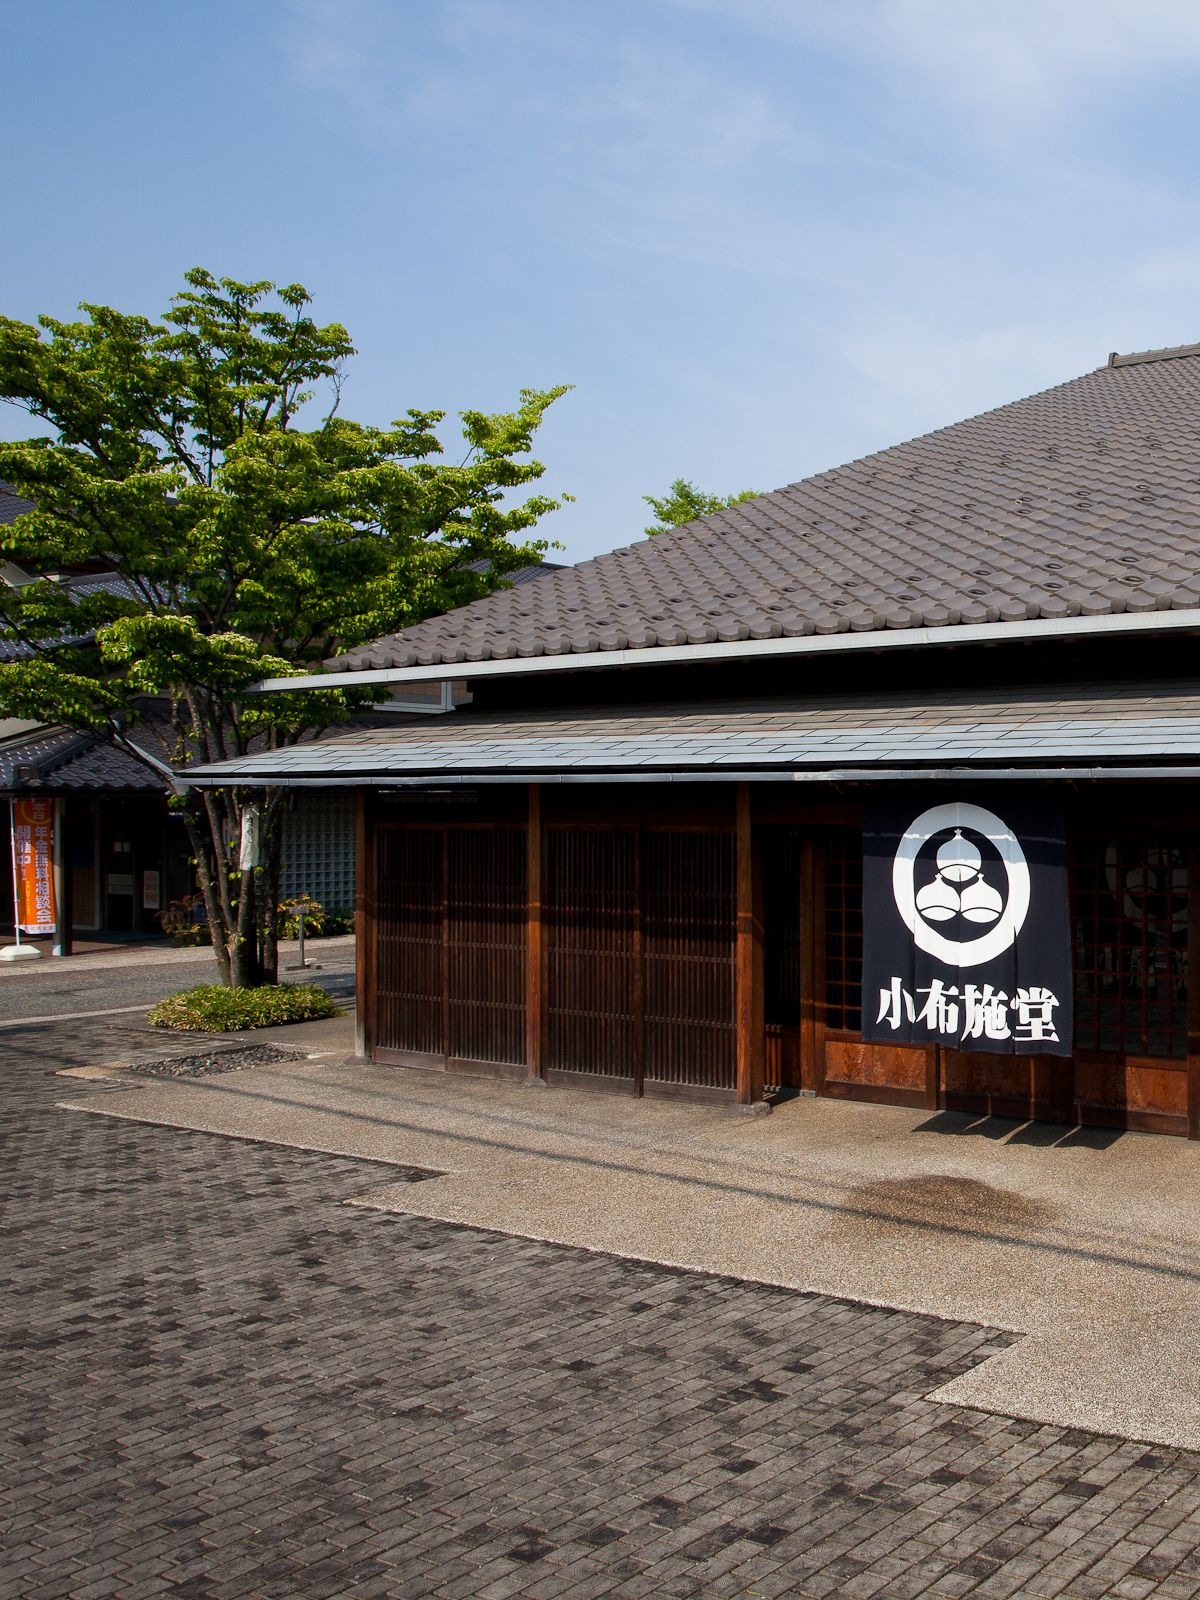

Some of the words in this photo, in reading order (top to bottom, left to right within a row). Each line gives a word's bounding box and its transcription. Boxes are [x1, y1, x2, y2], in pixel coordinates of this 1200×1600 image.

[34, 825, 52, 923] 年金無料相談会
[876, 976, 1060, 1042] 小布施堂
